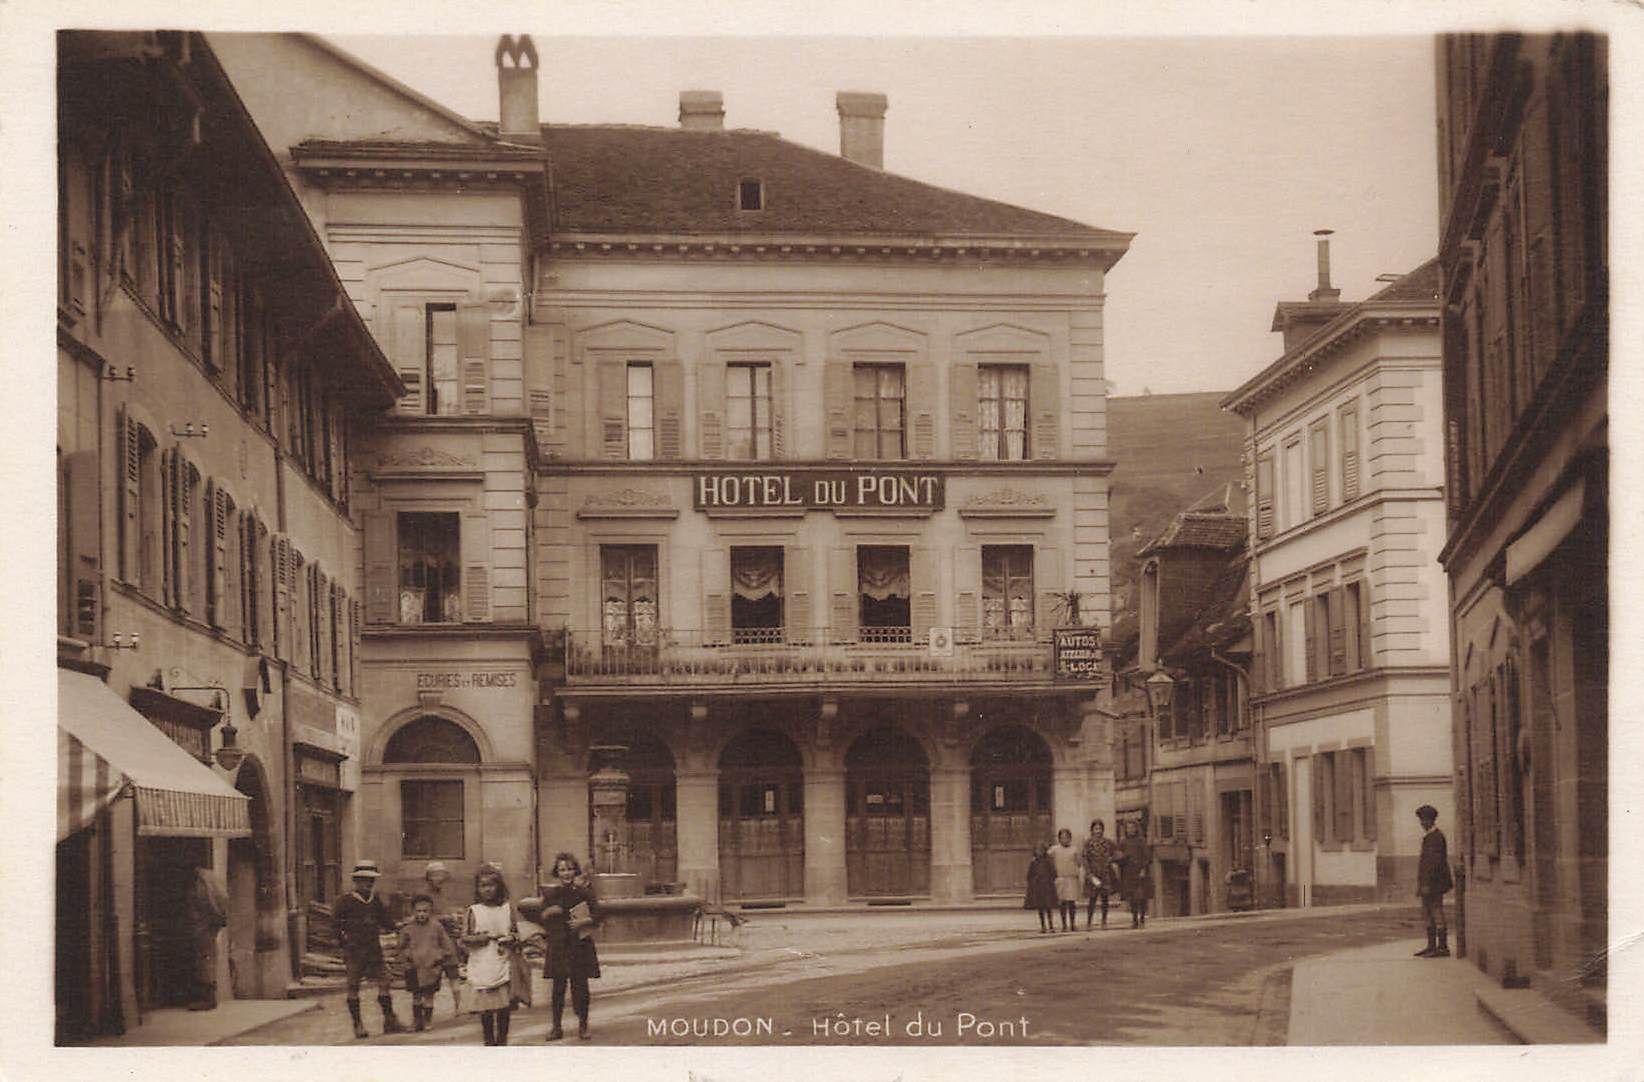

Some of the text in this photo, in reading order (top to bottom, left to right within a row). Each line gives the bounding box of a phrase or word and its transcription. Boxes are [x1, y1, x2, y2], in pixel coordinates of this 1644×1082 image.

[699, 476, 938, 505] HOTEL DU PONT
[417, 673, 461, 688] ECURIES
[472, 673, 516, 688] REMISES
